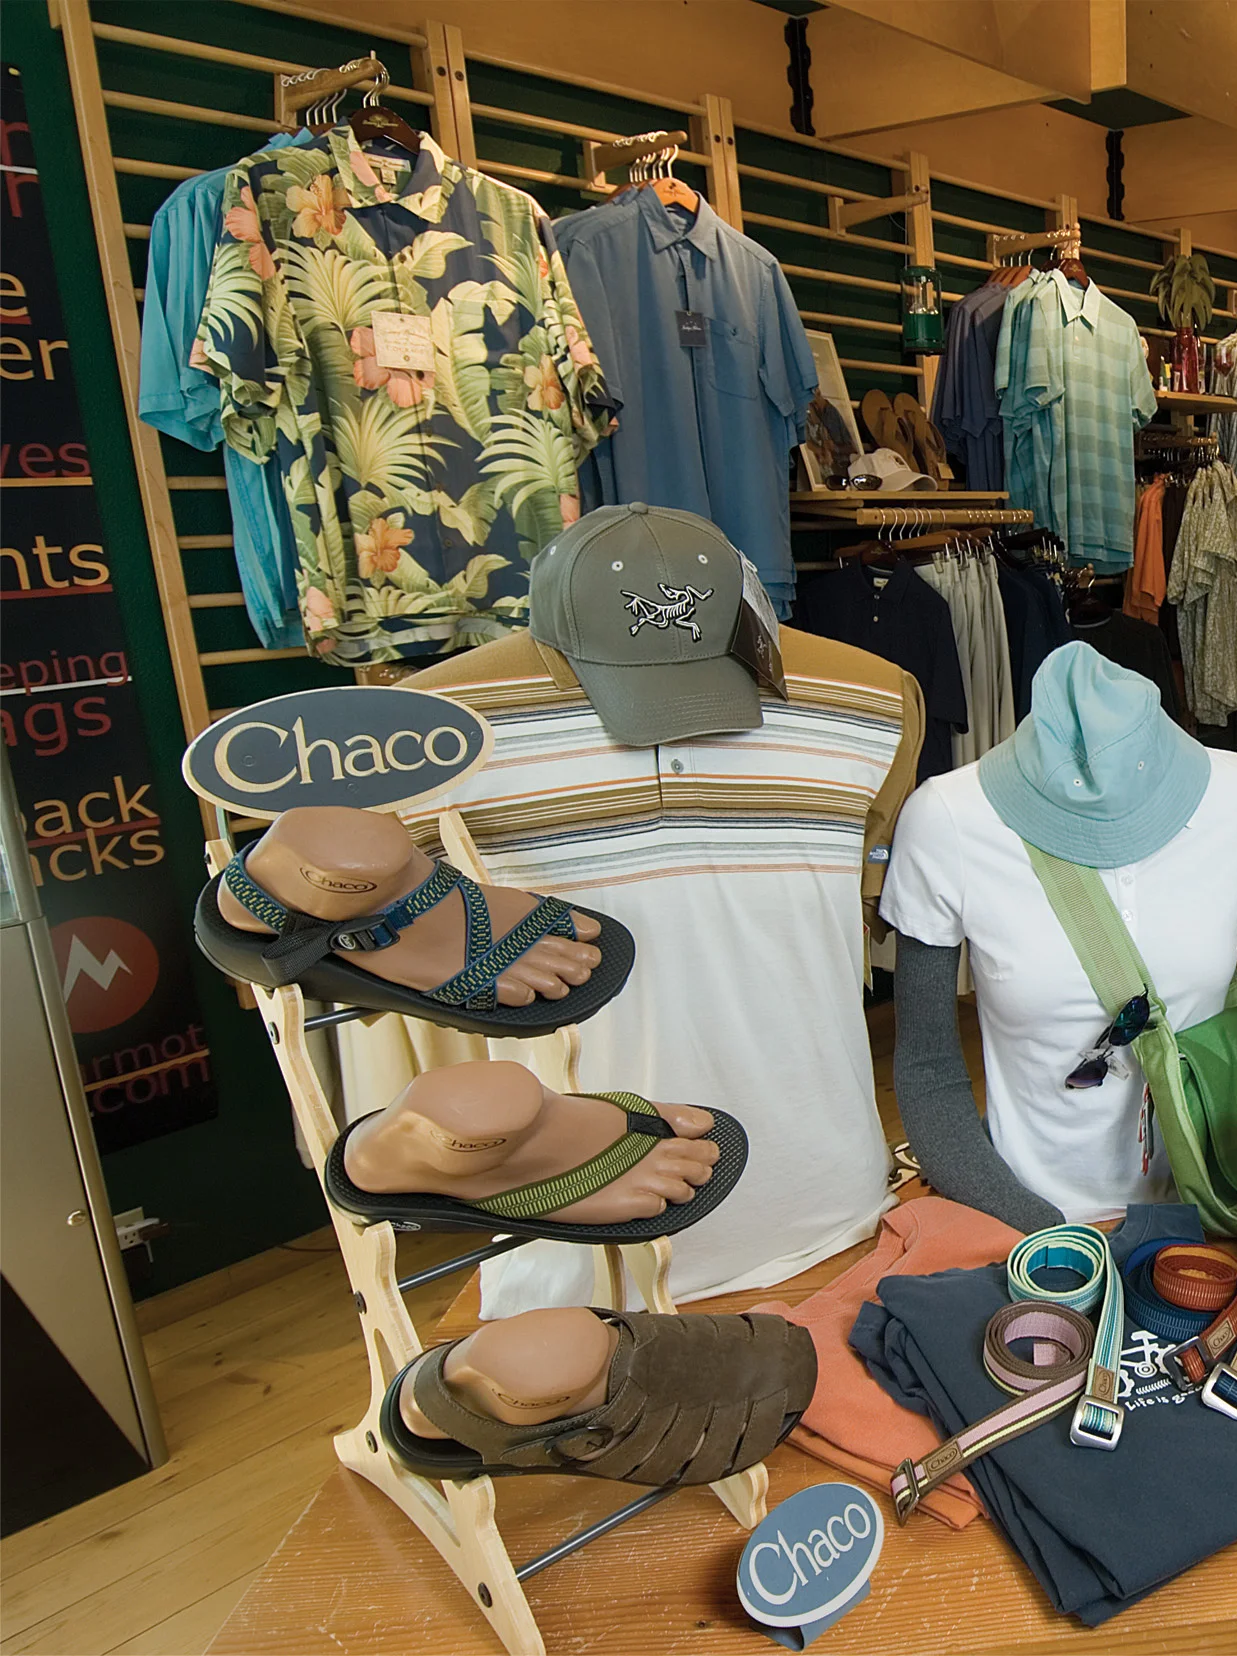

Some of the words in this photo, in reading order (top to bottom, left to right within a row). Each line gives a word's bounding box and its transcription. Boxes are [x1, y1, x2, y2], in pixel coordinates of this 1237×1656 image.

[213, 715, 469, 794] Chaco
[20, 775, 158, 839] ack
[305, 870, 369, 891] Chaco
[1124, 1397, 1155, 1411] Life
[1156, 1396, 1169, 1404] is
[748, 1503, 871, 1605] Chaco
